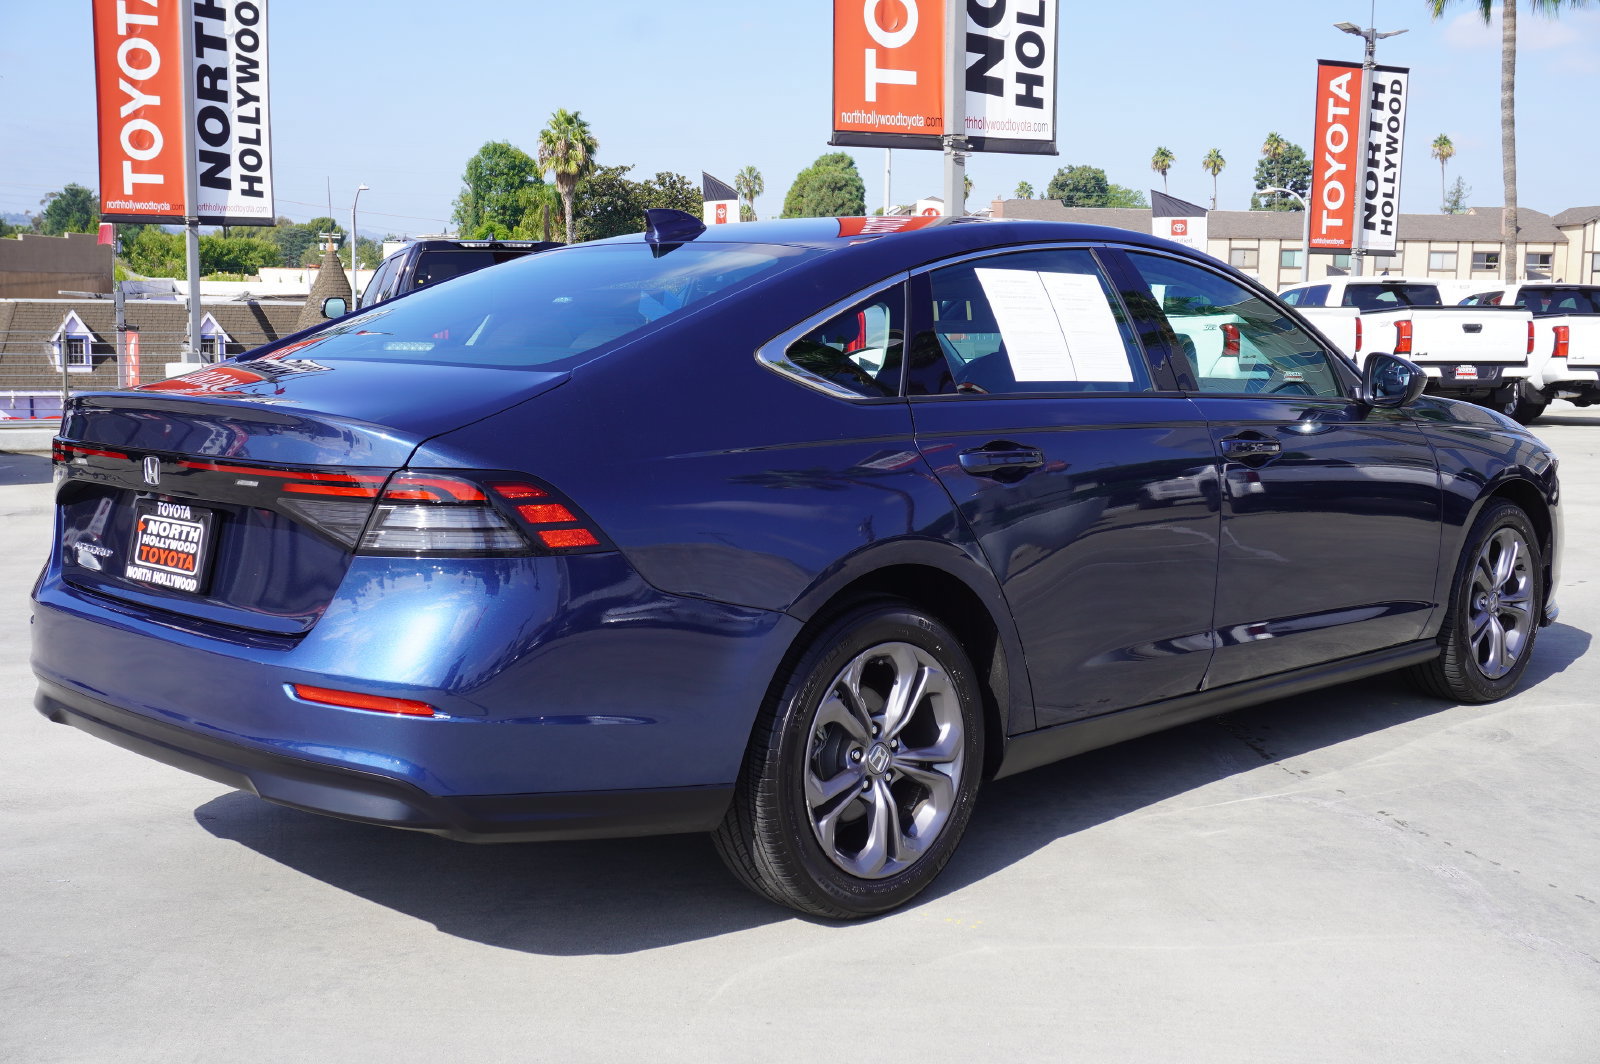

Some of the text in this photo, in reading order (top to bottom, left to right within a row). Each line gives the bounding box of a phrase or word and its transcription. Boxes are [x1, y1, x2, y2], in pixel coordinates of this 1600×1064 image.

[864, 0, 919, 102] TO
[117, 0, 164, 195] TOYOT
[841, 110, 943, 130] northhollywoodtoyota.com
[1321, 72, 1352, 234] TOYOTA
[1363, 82, 1386, 231] NORTH
[1380, 79, 1403, 236] HOLLYWOOD
[106, 200, 185, 213] northhollywoodtoyota.com
[197, 202, 268, 214] orthhollywoodtoyota.com
[157, 502, 191, 519] TOYOTA
[141, 534, 197, 553] HOLLYWOOD
[147, 520, 200, 542] NORTH
[140, 545, 194, 571] TOYOTA
[126, 566, 197, 591] NORTH HOLLYWOOD
